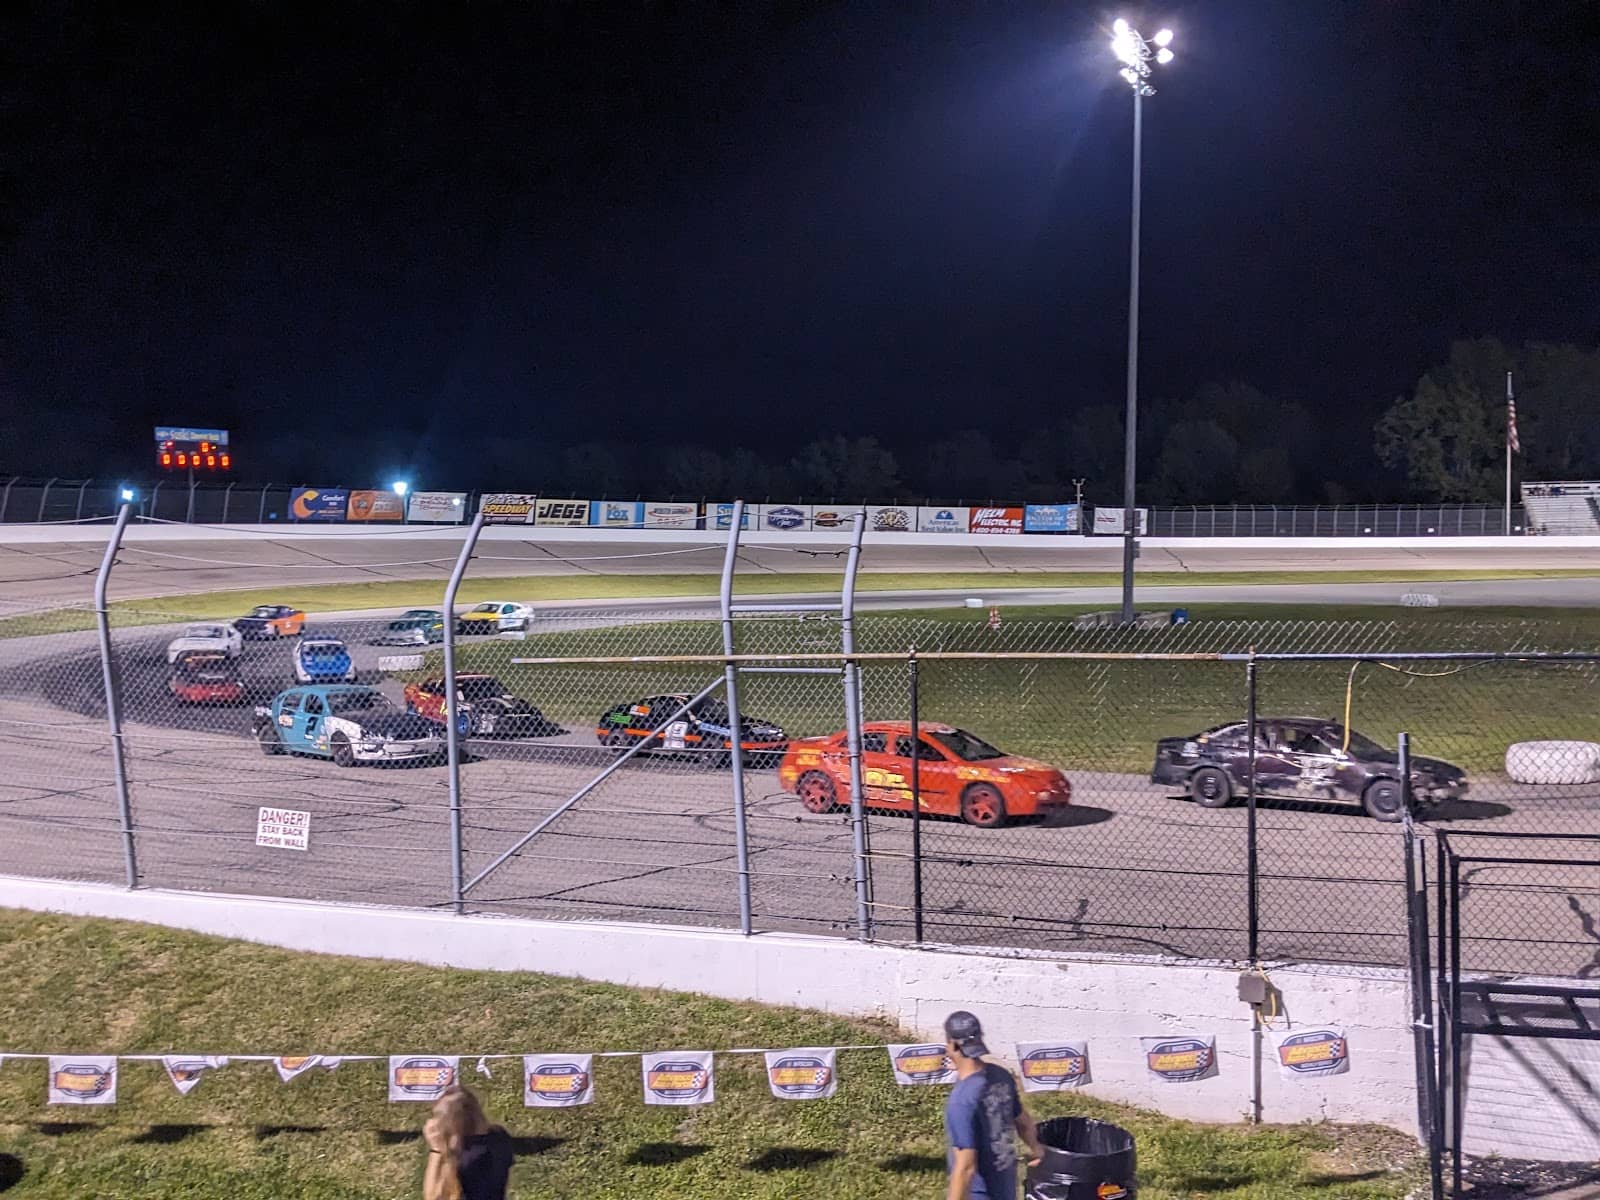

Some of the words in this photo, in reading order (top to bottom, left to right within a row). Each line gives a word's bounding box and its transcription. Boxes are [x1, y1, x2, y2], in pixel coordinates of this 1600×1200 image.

[482, 503, 533, 514] SPEEDWAY
[538, 503, 587, 519] JEGS
[304, 716, 319, 740] 2
[261, 825, 280, 834] STAY
[282, 827, 304, 837] BACK
